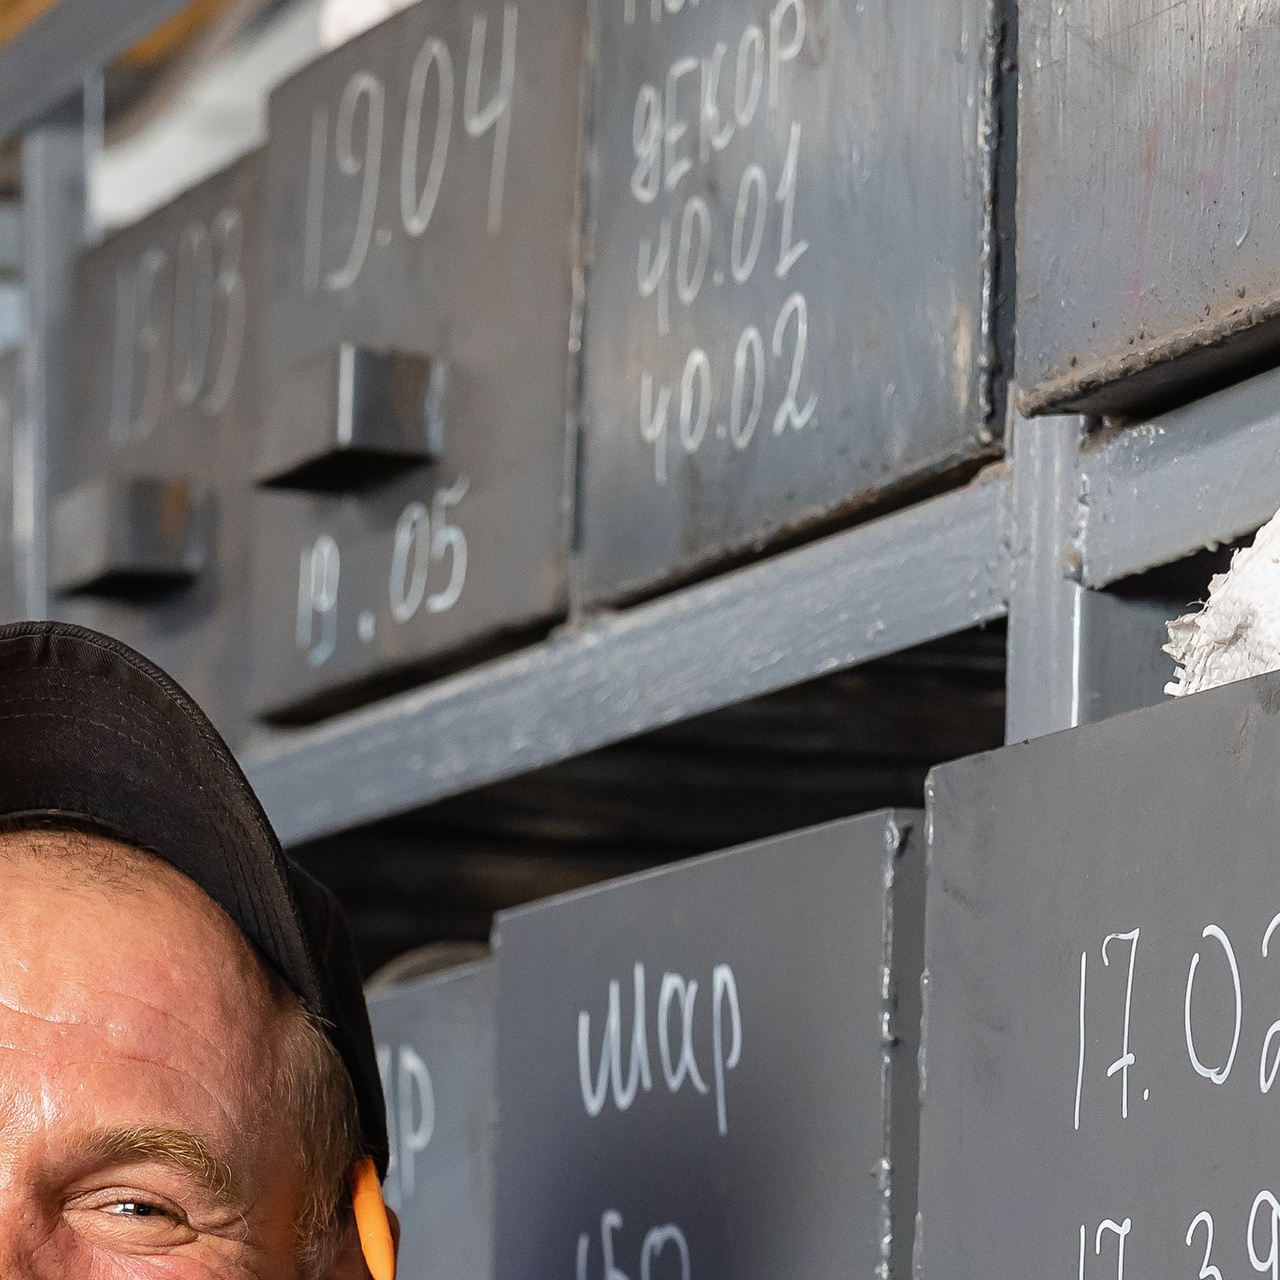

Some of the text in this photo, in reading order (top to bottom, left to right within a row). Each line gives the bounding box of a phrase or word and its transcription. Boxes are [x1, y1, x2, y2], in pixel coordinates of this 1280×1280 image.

[302, 0, 518, 292] 19.04
[637, 118, 810, 334] 40.01
[640, 292, 819, 486] 40.02
